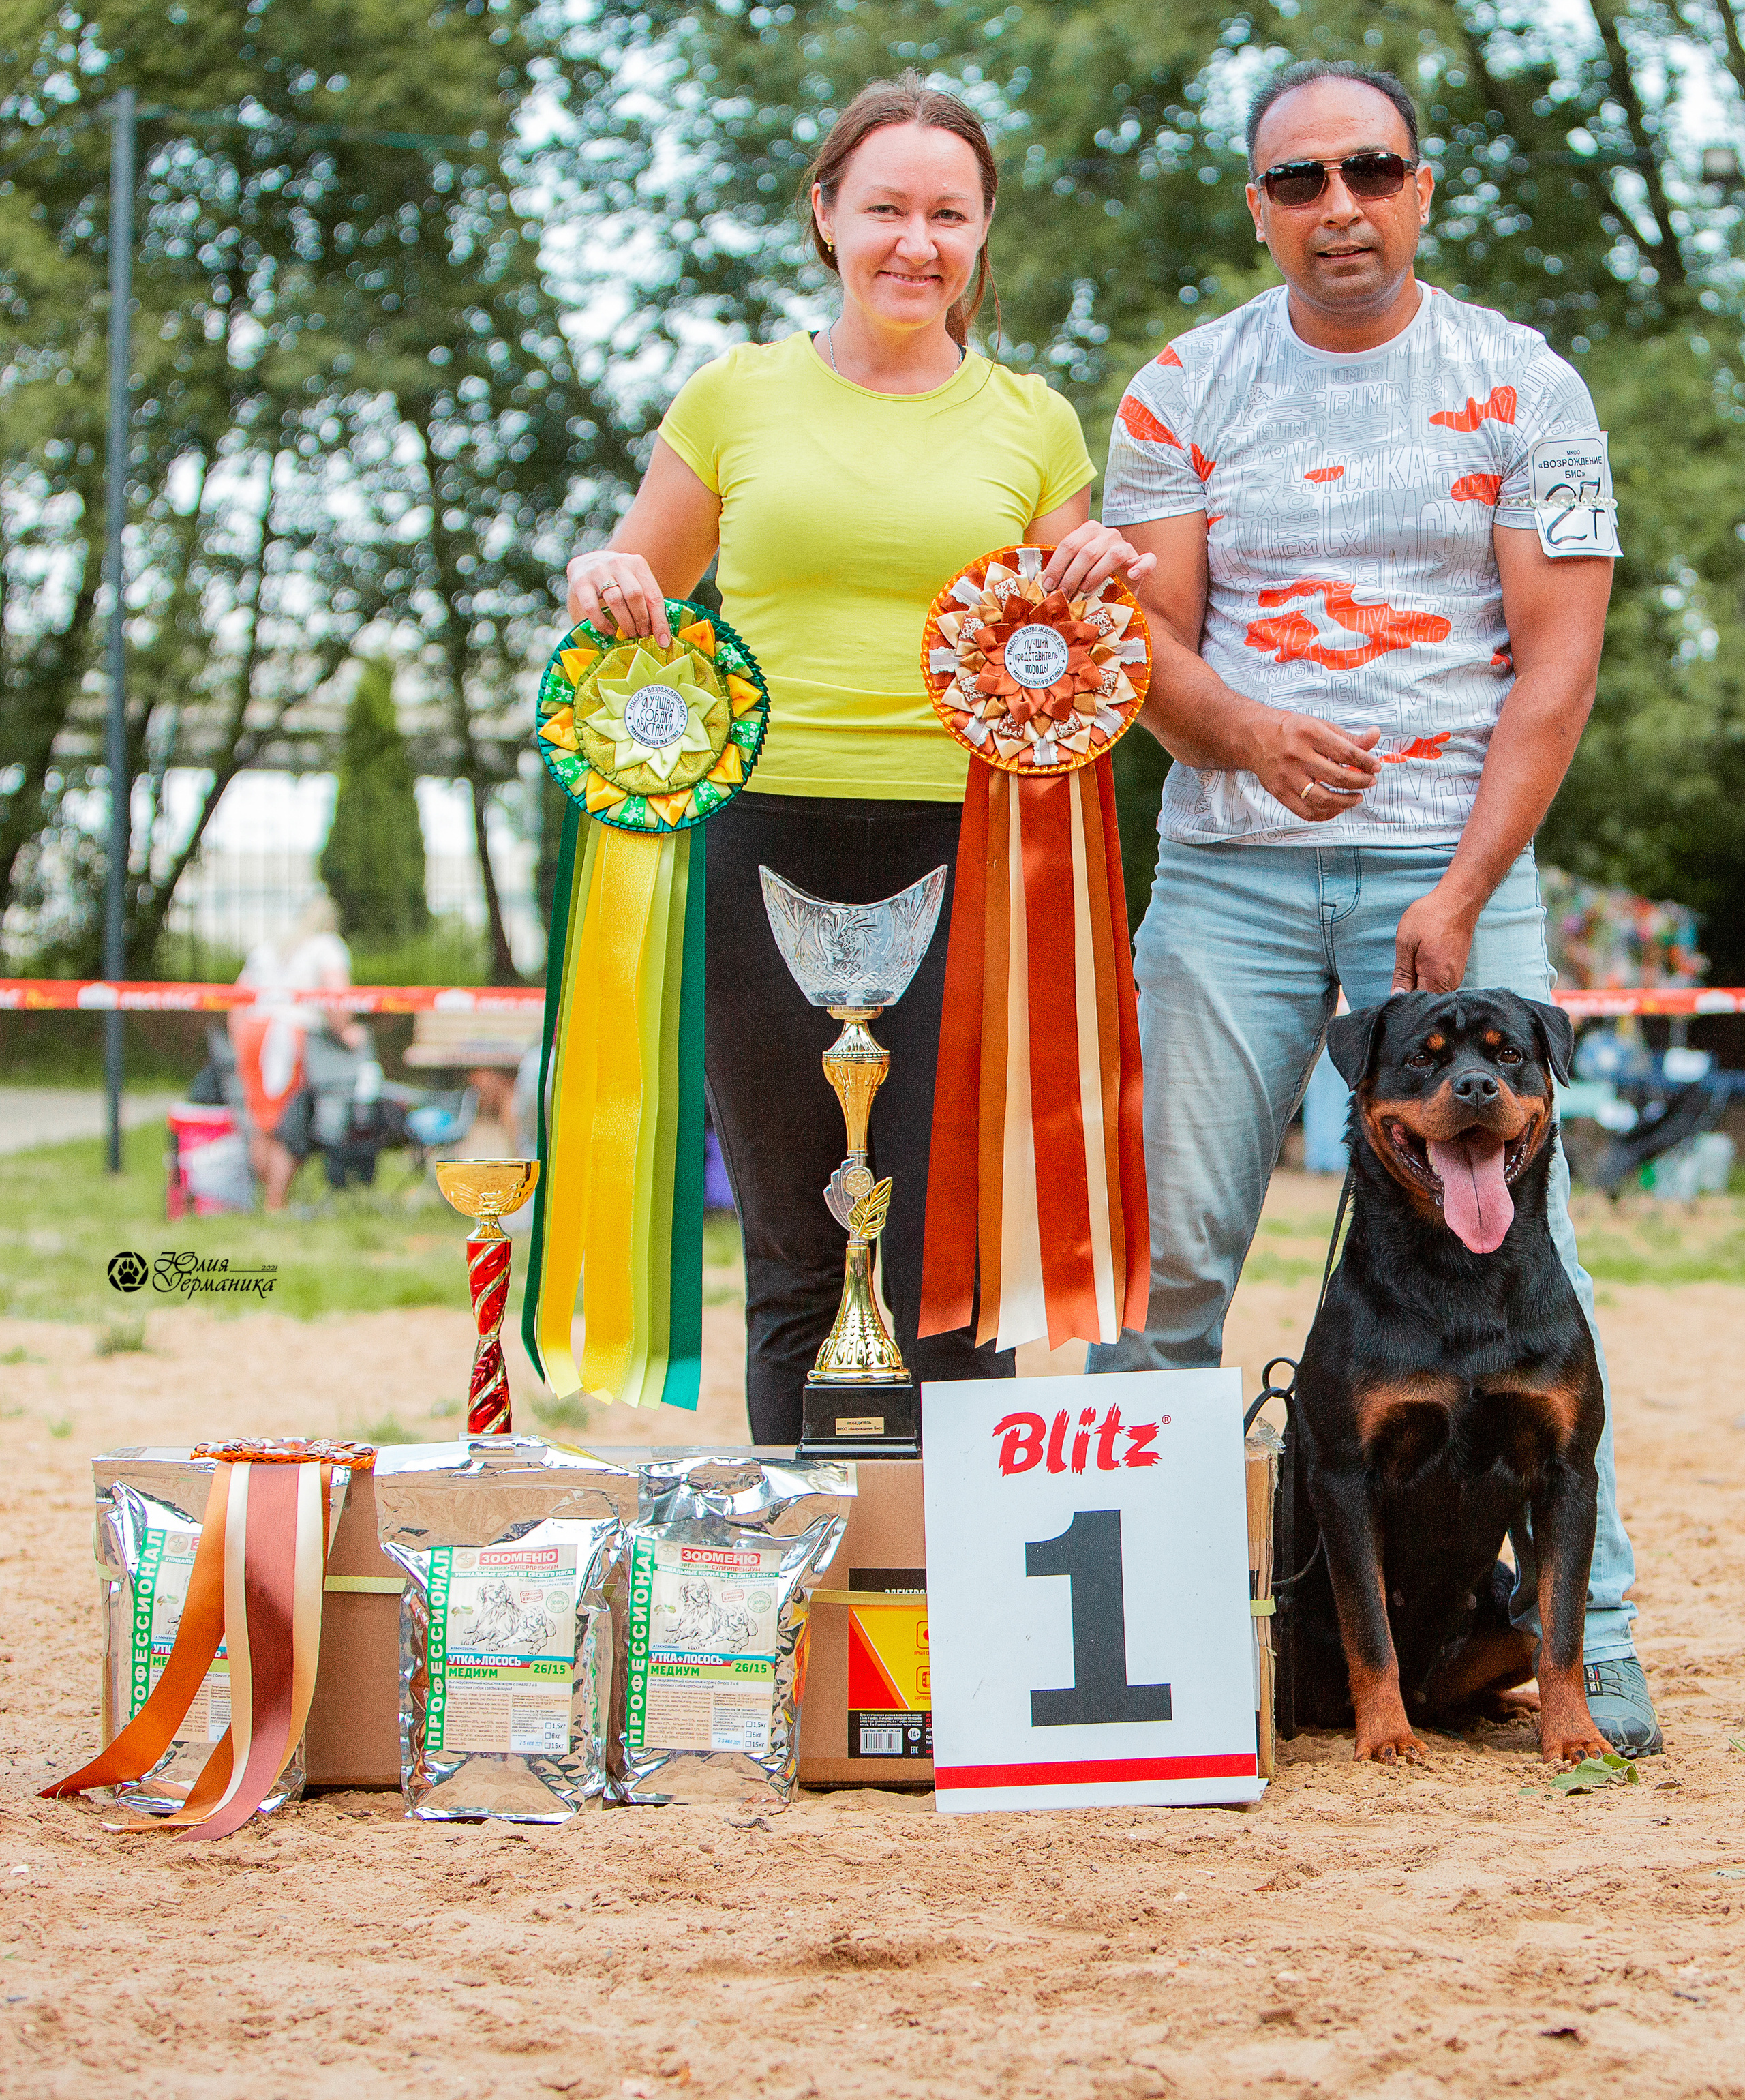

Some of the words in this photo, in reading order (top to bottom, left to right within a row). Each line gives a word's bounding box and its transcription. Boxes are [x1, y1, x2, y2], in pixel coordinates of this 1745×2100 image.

[1538, 456, 1603, 468] «ВОЗРОЖДЕНИЕ
[1565, 470, 1585, 479] БИС»
[1015, 651, 1058, 663] представитель
[1025, 663, 1048, 677] породы
[641, 695, 675, 712] ЛУЧШАЯ
[640, 708, 673, 723] СОБАКА
[637, 719, 673, 736] ВЫСТАВКИ
[481, 1551, 556, 1563] ЗООМЕНЮ
[682, 1550, 759, 1565] ЗООМЕНЮ
[657, 1565, 697, 1576] УНИКАЛЬНЫЕ
[1025, 1509, 1172, 1727] 1
[629, 1540, 652, 1744] ПРОФЕССИОНАЛ
[427, 1550, 451, 1747] ПРОФЕССИОНАЛ
[449, 1655, 521, 1666] УТКА+ЛОСОСЬ
[651, 1652, 723, 1665] УТКА+ЛОСОСЬ
[449, 1668, 498, 1678] МЕДИУМ
[534, 1664, 566, 1675] 26/15
[650, 1665, 700, 1677] МЕДИУМ
[735, 1662, 767, 1674] 26/15
